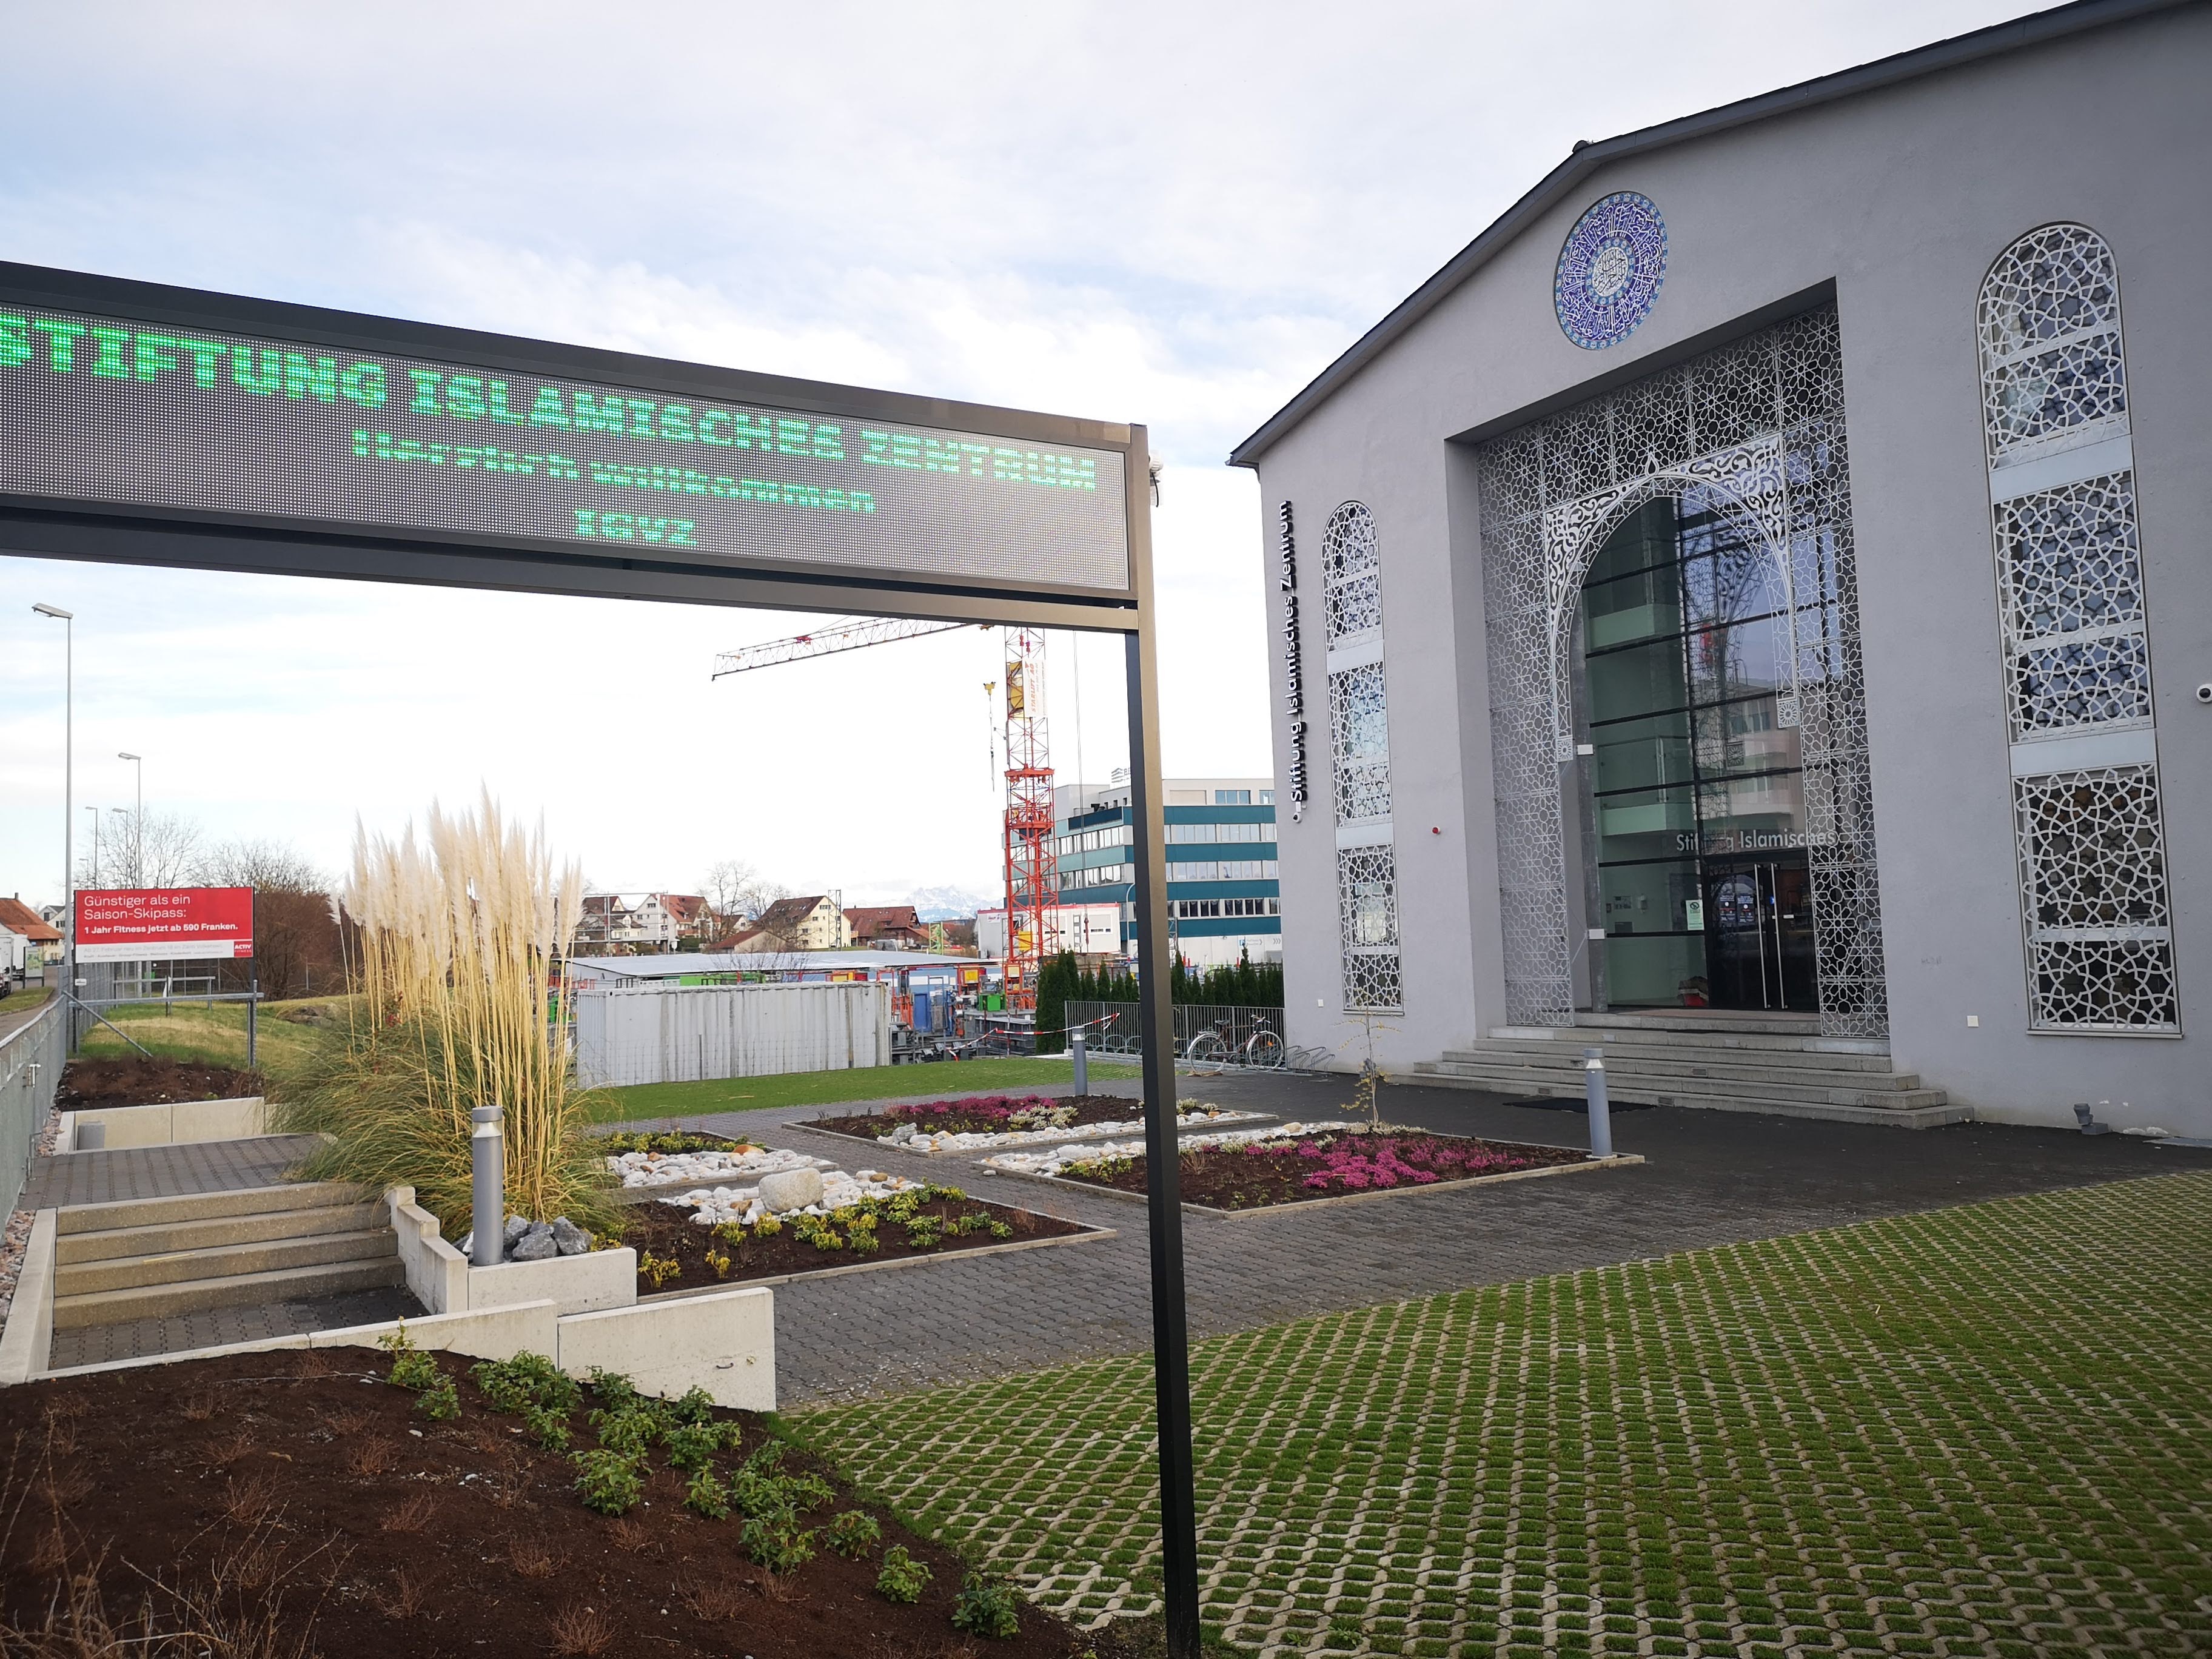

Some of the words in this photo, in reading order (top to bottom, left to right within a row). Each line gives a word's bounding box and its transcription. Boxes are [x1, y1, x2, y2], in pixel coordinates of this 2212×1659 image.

[0, 313, 387, 409] STIFTUNG
[407, 369, 846, 460] ISLAMISCHES
[861, 429, 1096, 491] ZENTRUM
[574, 509, 697, 545] IGVZ
[1279, 500, 1292, 591] Zentrum
[1282, 595, 1298, 714] Islamisches
[1289, 722, 1302, 802] Stiftung
[84, 895, 147, 908] Günstiger
[150, 894, 169, 905] als
[172, 894, 190, 905] ein
[84, 908, 187, 920] Saison-Skipass:
[113, 925, 146, 933] Fitness
[147, 924, 169, 934] jetzt
